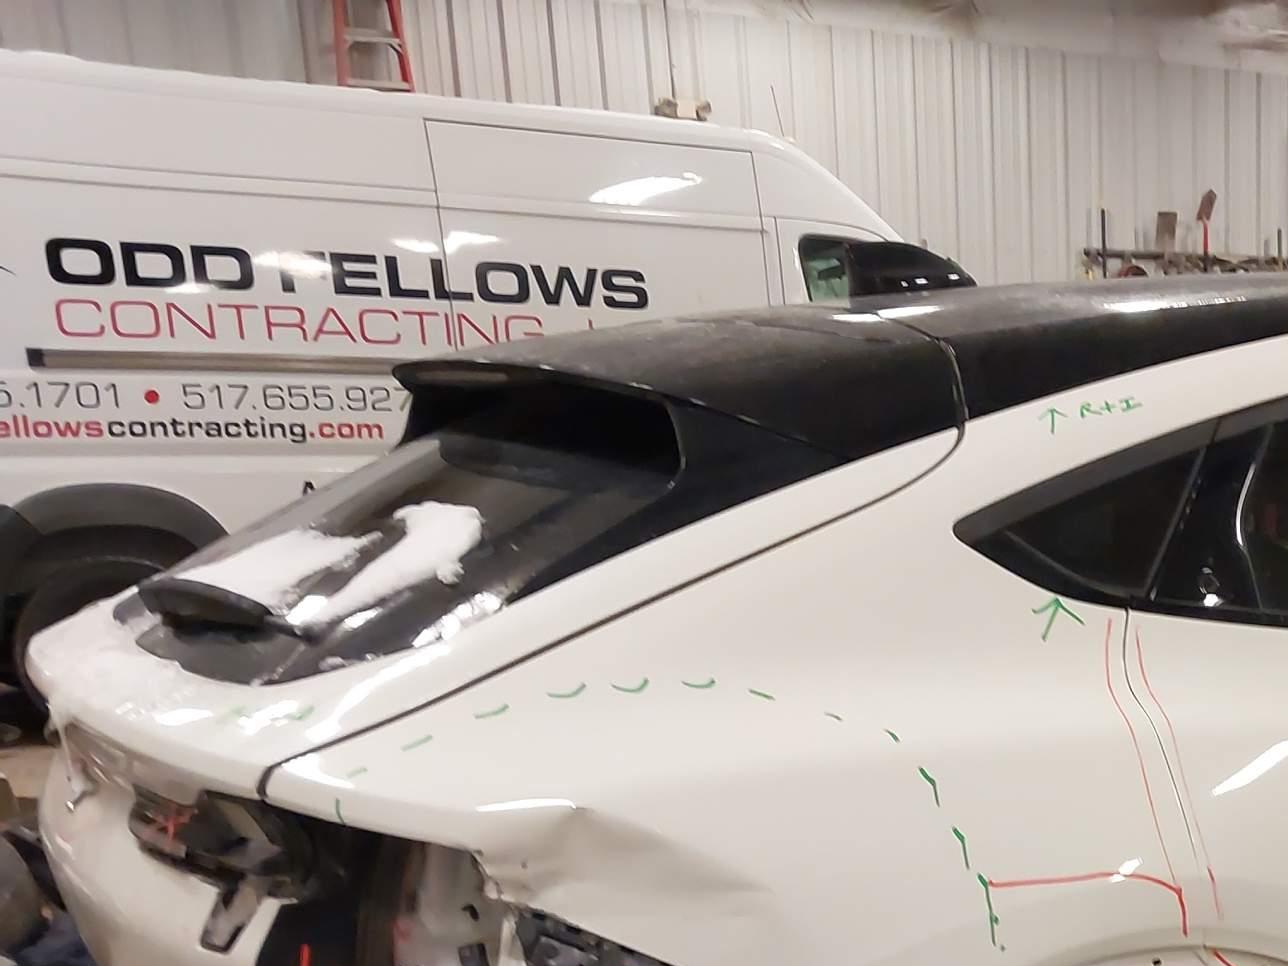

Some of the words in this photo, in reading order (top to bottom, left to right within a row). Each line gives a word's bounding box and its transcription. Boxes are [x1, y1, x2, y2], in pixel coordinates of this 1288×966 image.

[45, 238, 254, 291] ODD
[280, 251, 649, 309] FELLOWS
[56, 299, 544, 347] CONTRACTING
